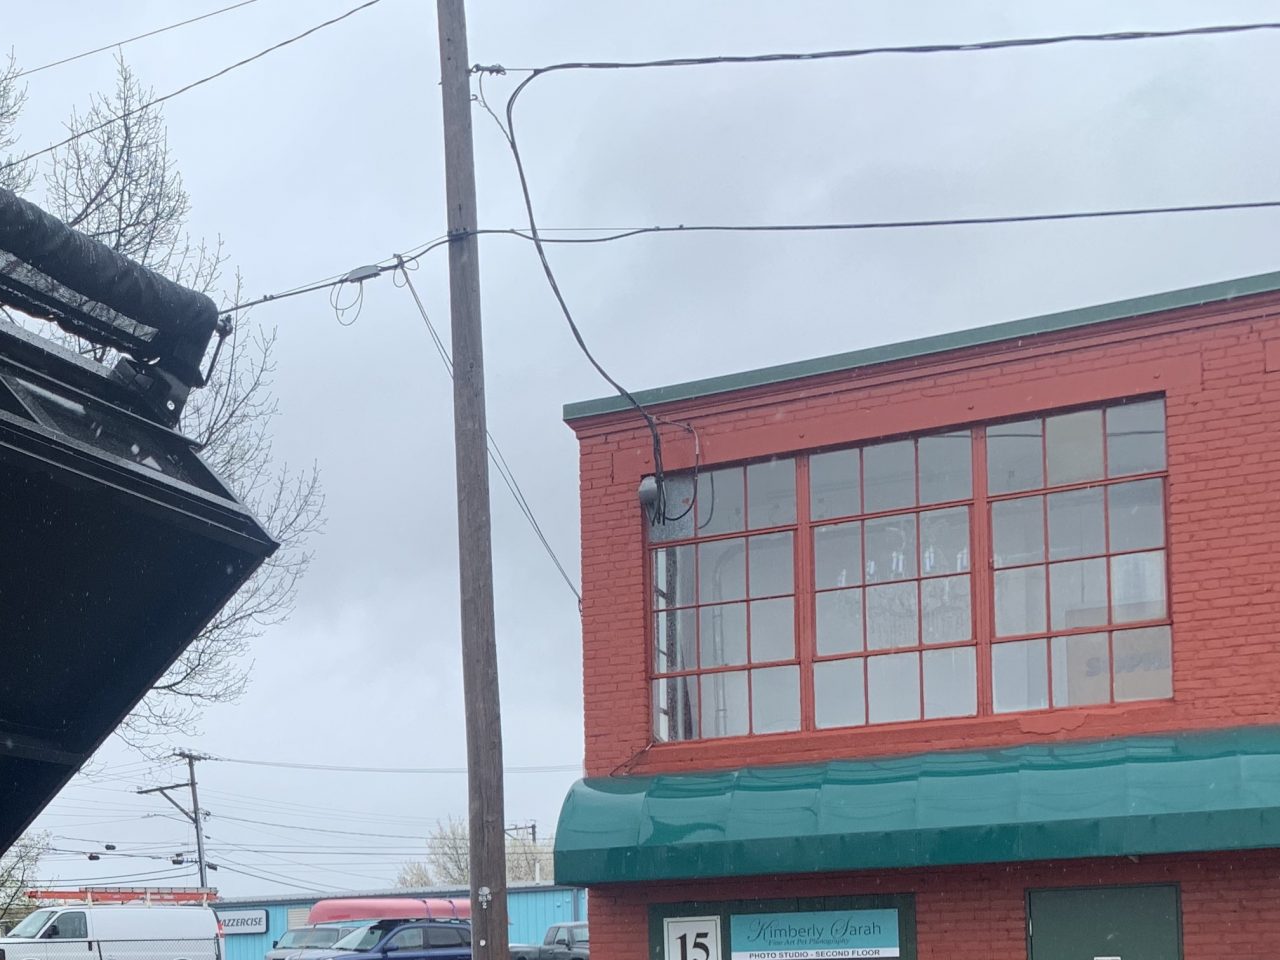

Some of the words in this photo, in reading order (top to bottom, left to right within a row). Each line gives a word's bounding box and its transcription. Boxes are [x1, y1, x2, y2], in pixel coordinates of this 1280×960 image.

[221, 917, 264, 928] AZZERCISE
[747, 918, 824, 942] Kimberly
[830, 916, 882, 939] Sarah
[778, 951, 809, 959] STUDIO
[815, 950, 850, 958] SECOND
[851, 949, 881, 957] FLOOR
